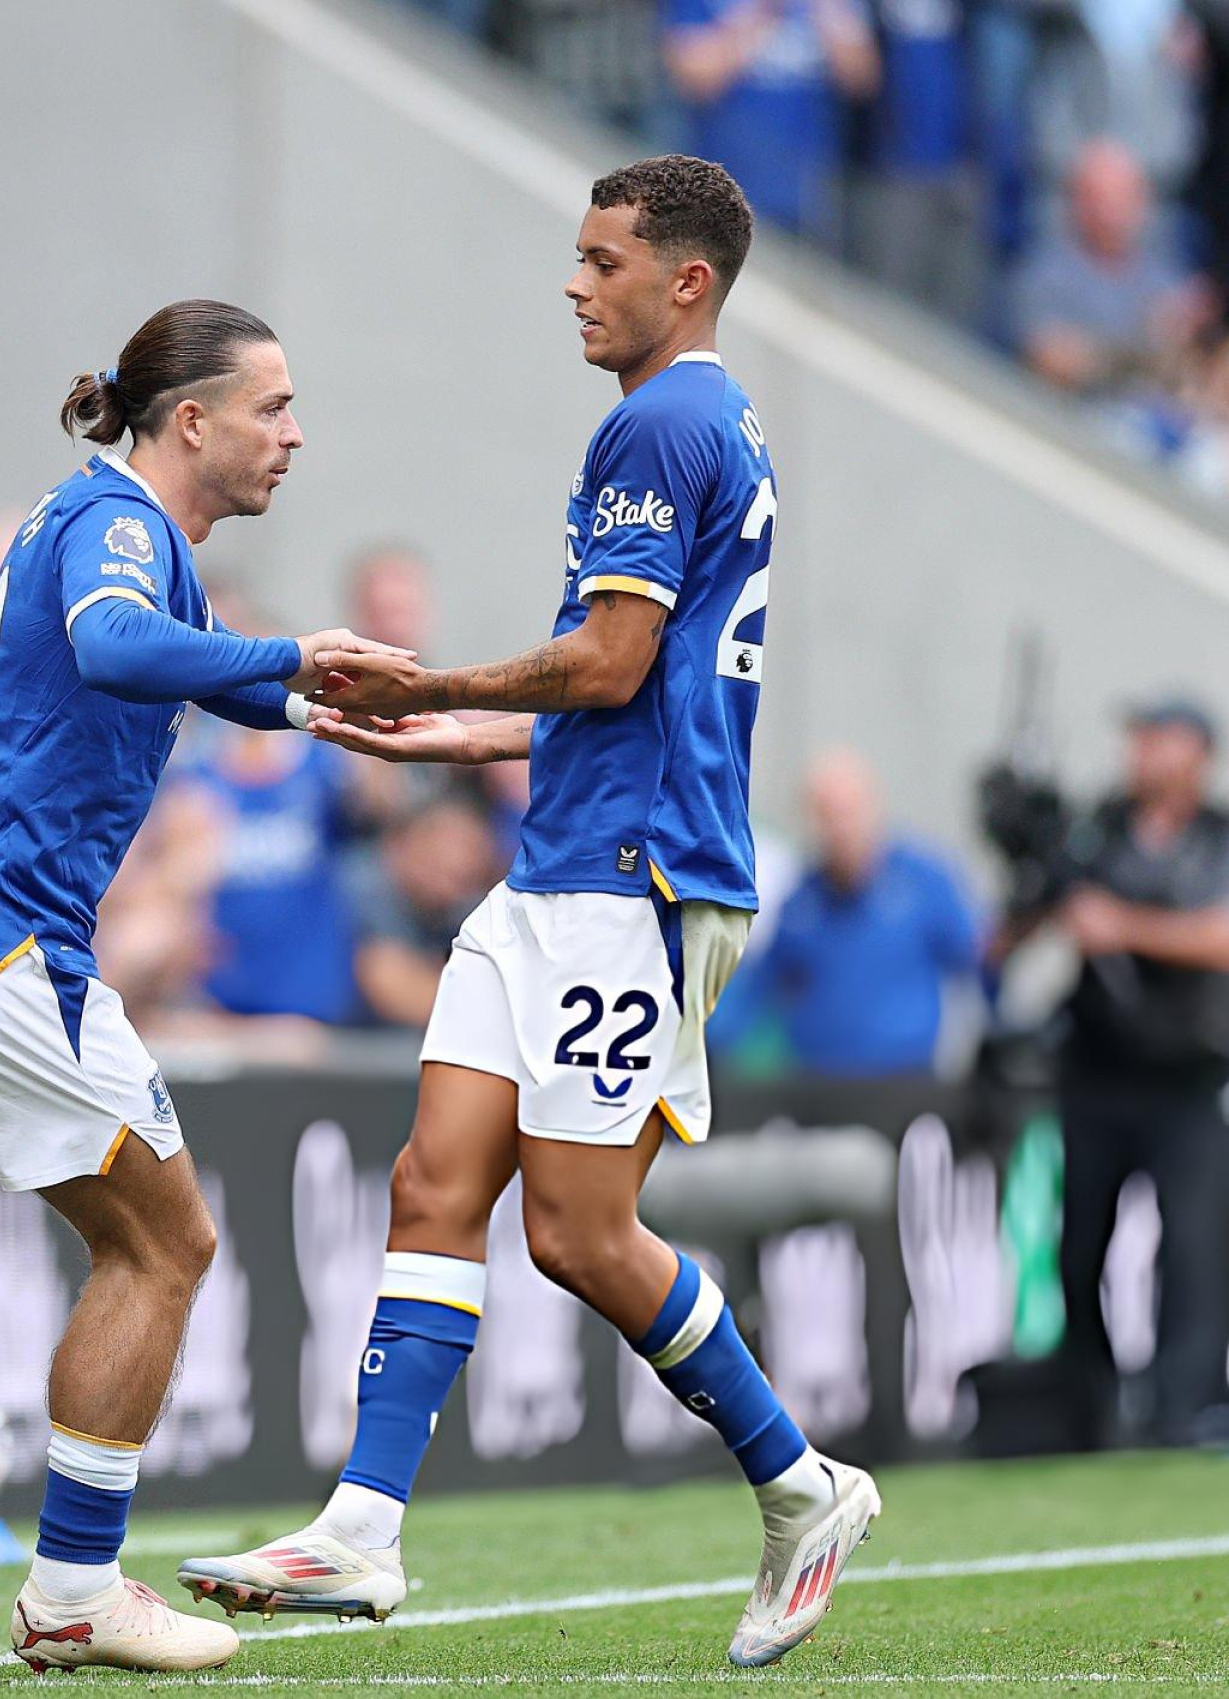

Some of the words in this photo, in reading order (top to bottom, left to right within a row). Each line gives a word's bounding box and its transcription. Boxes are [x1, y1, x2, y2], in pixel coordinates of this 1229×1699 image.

[738, 401, 765, 458] JO
[592, 486, 674, 538] Stake
[554, 984, 659, 1070] 22
